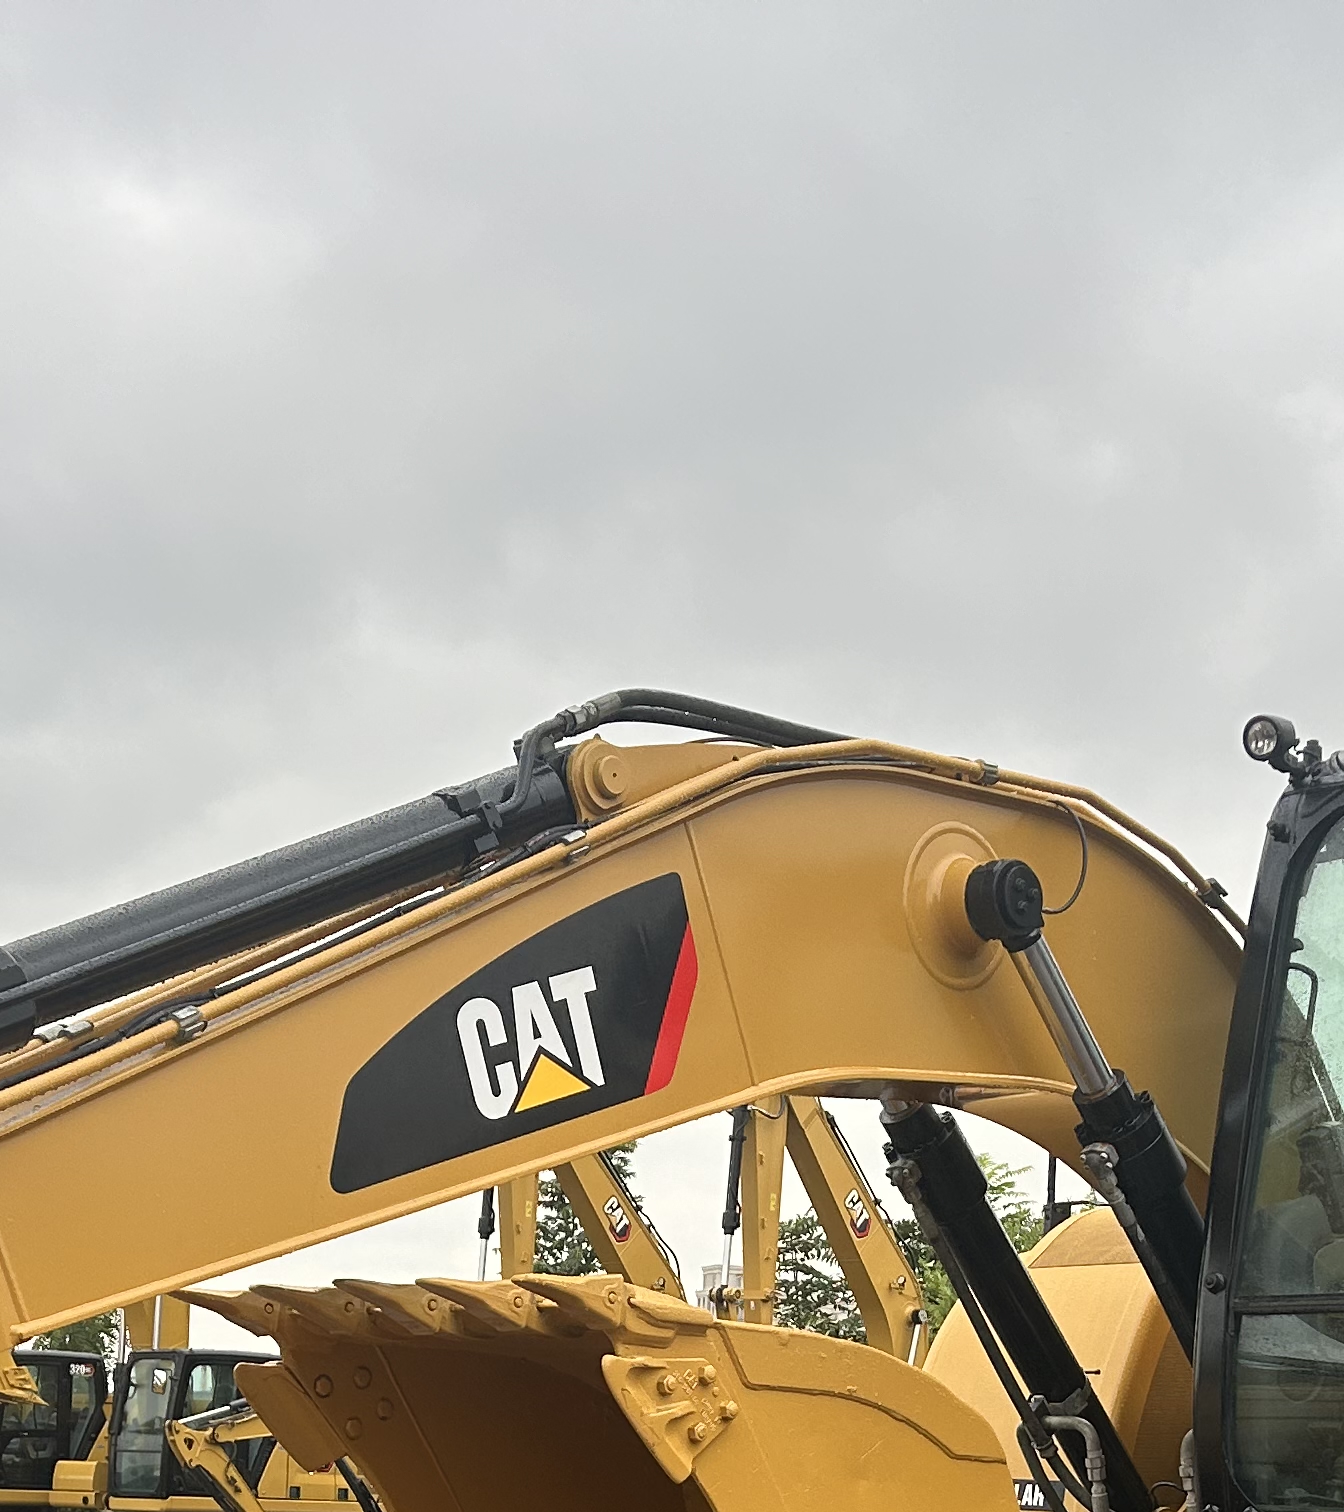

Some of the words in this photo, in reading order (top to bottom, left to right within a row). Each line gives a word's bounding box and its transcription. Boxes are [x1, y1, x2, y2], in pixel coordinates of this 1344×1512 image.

[457, 965, 605, 1120] CAT
[603, 1196, 630, 1233] CAT
[844, 1188, 870, 1229] CAT
[69, 1363, 85, 1376] 320
